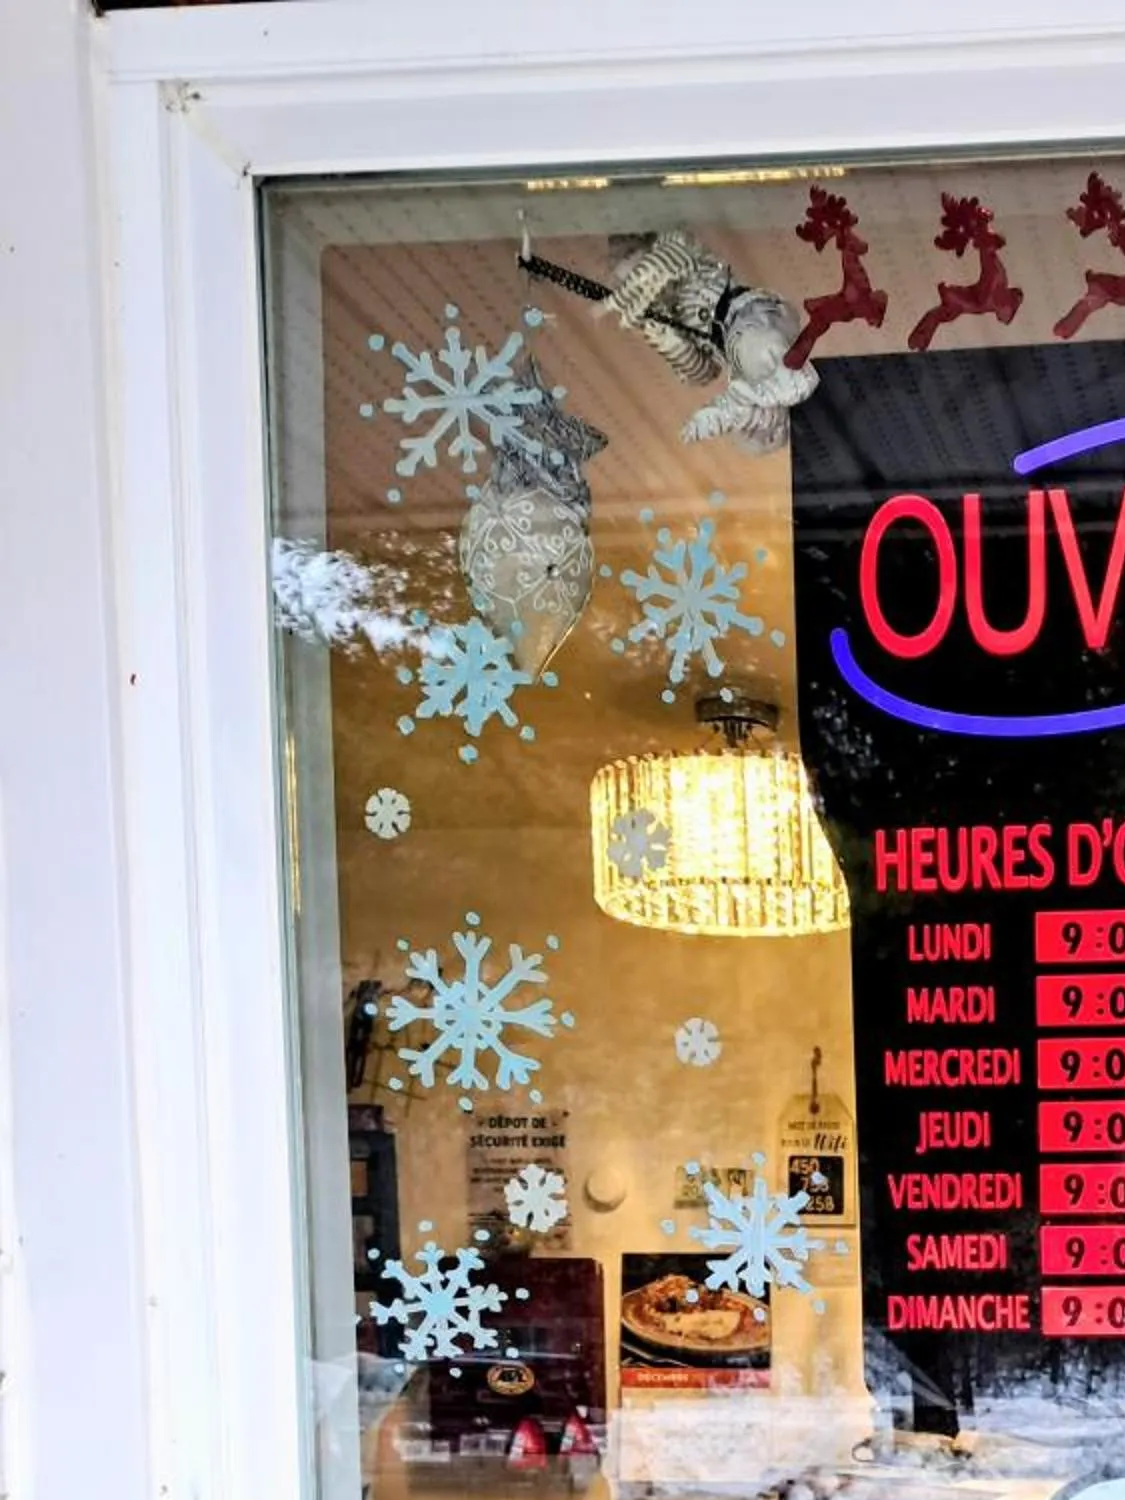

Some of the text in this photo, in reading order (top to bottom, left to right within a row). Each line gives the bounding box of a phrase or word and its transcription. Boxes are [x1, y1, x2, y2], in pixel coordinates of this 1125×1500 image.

[875, 823, 1055, 893] HEURES
[909, 924, 991, 961] LUNDI
[907, 987, 995, 1023] MARDI
[885, 1049, 1021, 1086] MERCREDI
[916, 1112, 990, 1154] JEUDI
[887, 1173, 1022, 1210] VENDREDI
[906, 1234, 1007, 1271] SAMEDI
[887, 1294, 1031, 1331] DIMANCHE
